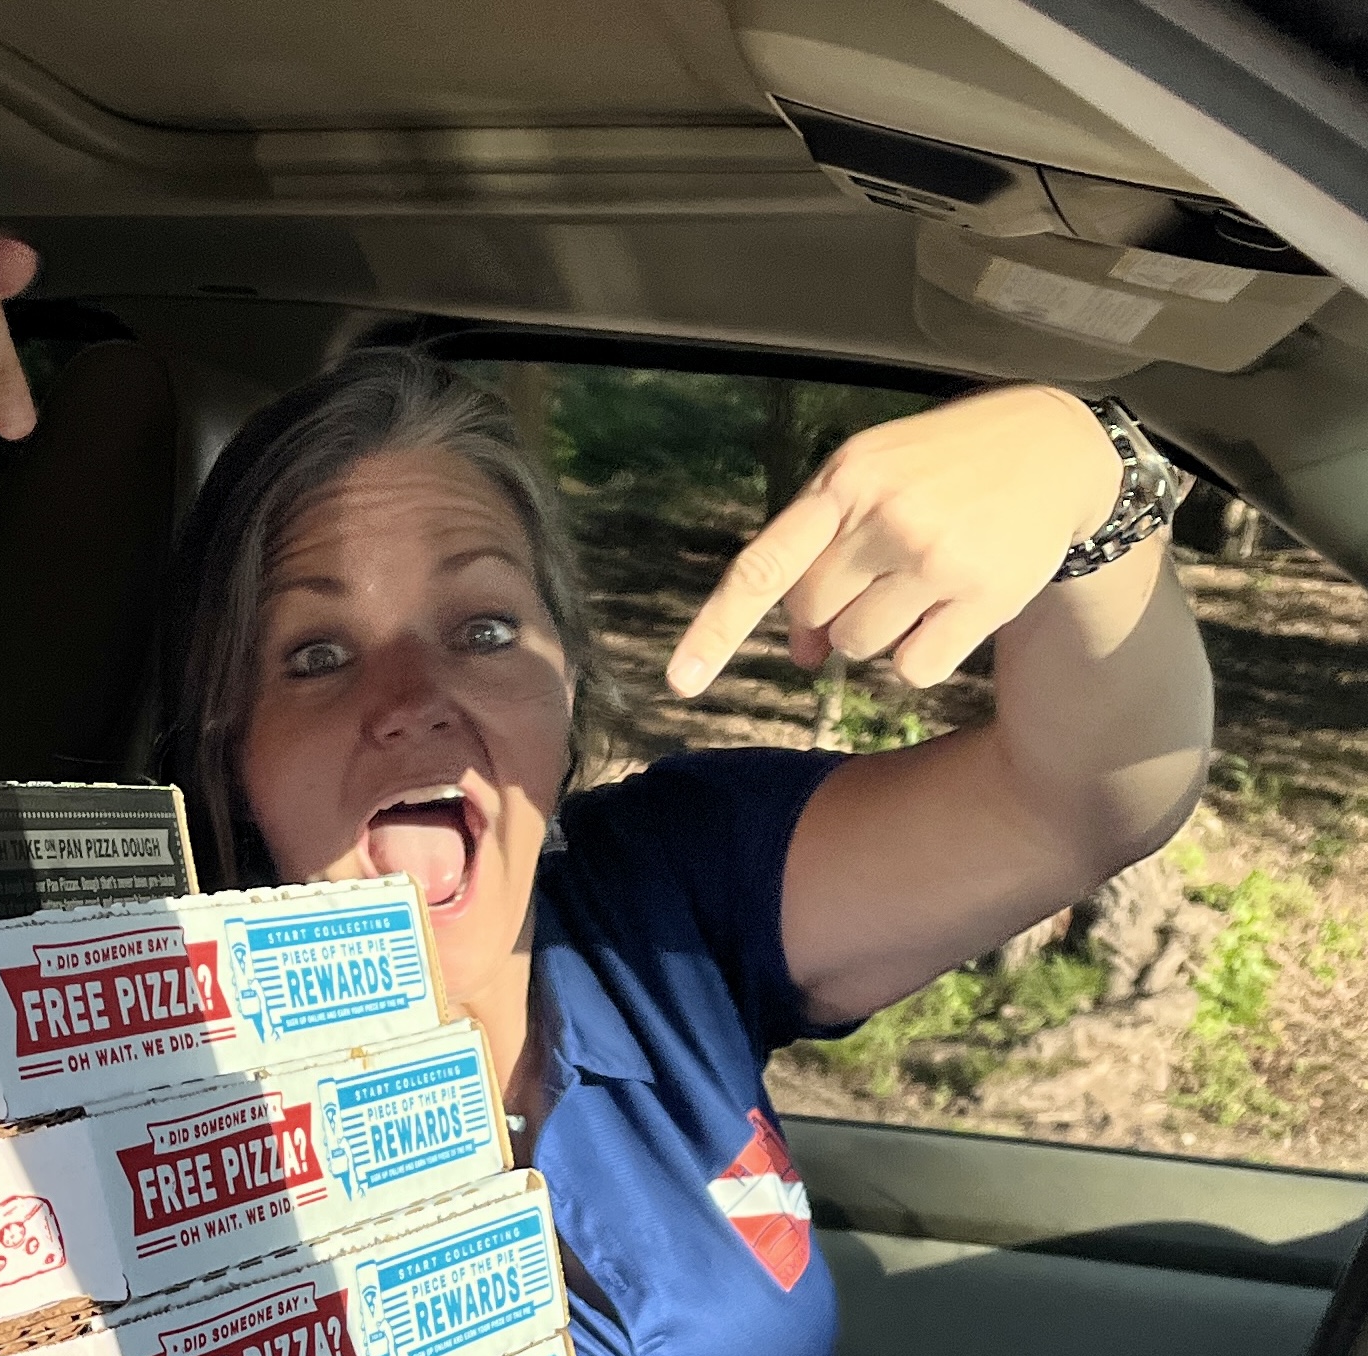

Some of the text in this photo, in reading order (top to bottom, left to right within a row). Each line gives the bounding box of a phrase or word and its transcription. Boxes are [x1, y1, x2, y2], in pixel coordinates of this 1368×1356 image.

[11, 839, 44, 861] TAKE
[45, 838, 56, 852] ON
[59, 838, 83, 859] PAN
[86, 838, 120, 858] PIZZA
[121, 837, 161, 857] DOUGH
[55, 938, 169, 969] DID SOMEONE SAY
[267, 918, 390, 945] START COLLECTING
[282, 939, 386, 965] PIECE OF THE PIE
[20, 964, 213, 1041] FREE PIZZA?
[286, 955, 393, 1008] REWARDS
[67, 1034, 198, 1071] OH WAIT. WE DID.
[371, 1102, 462, 1163] REWARDS
[136, 1128, 307, 1219] FREE PIZZA?
[415, 1266, 520, 1341] REWARDS
